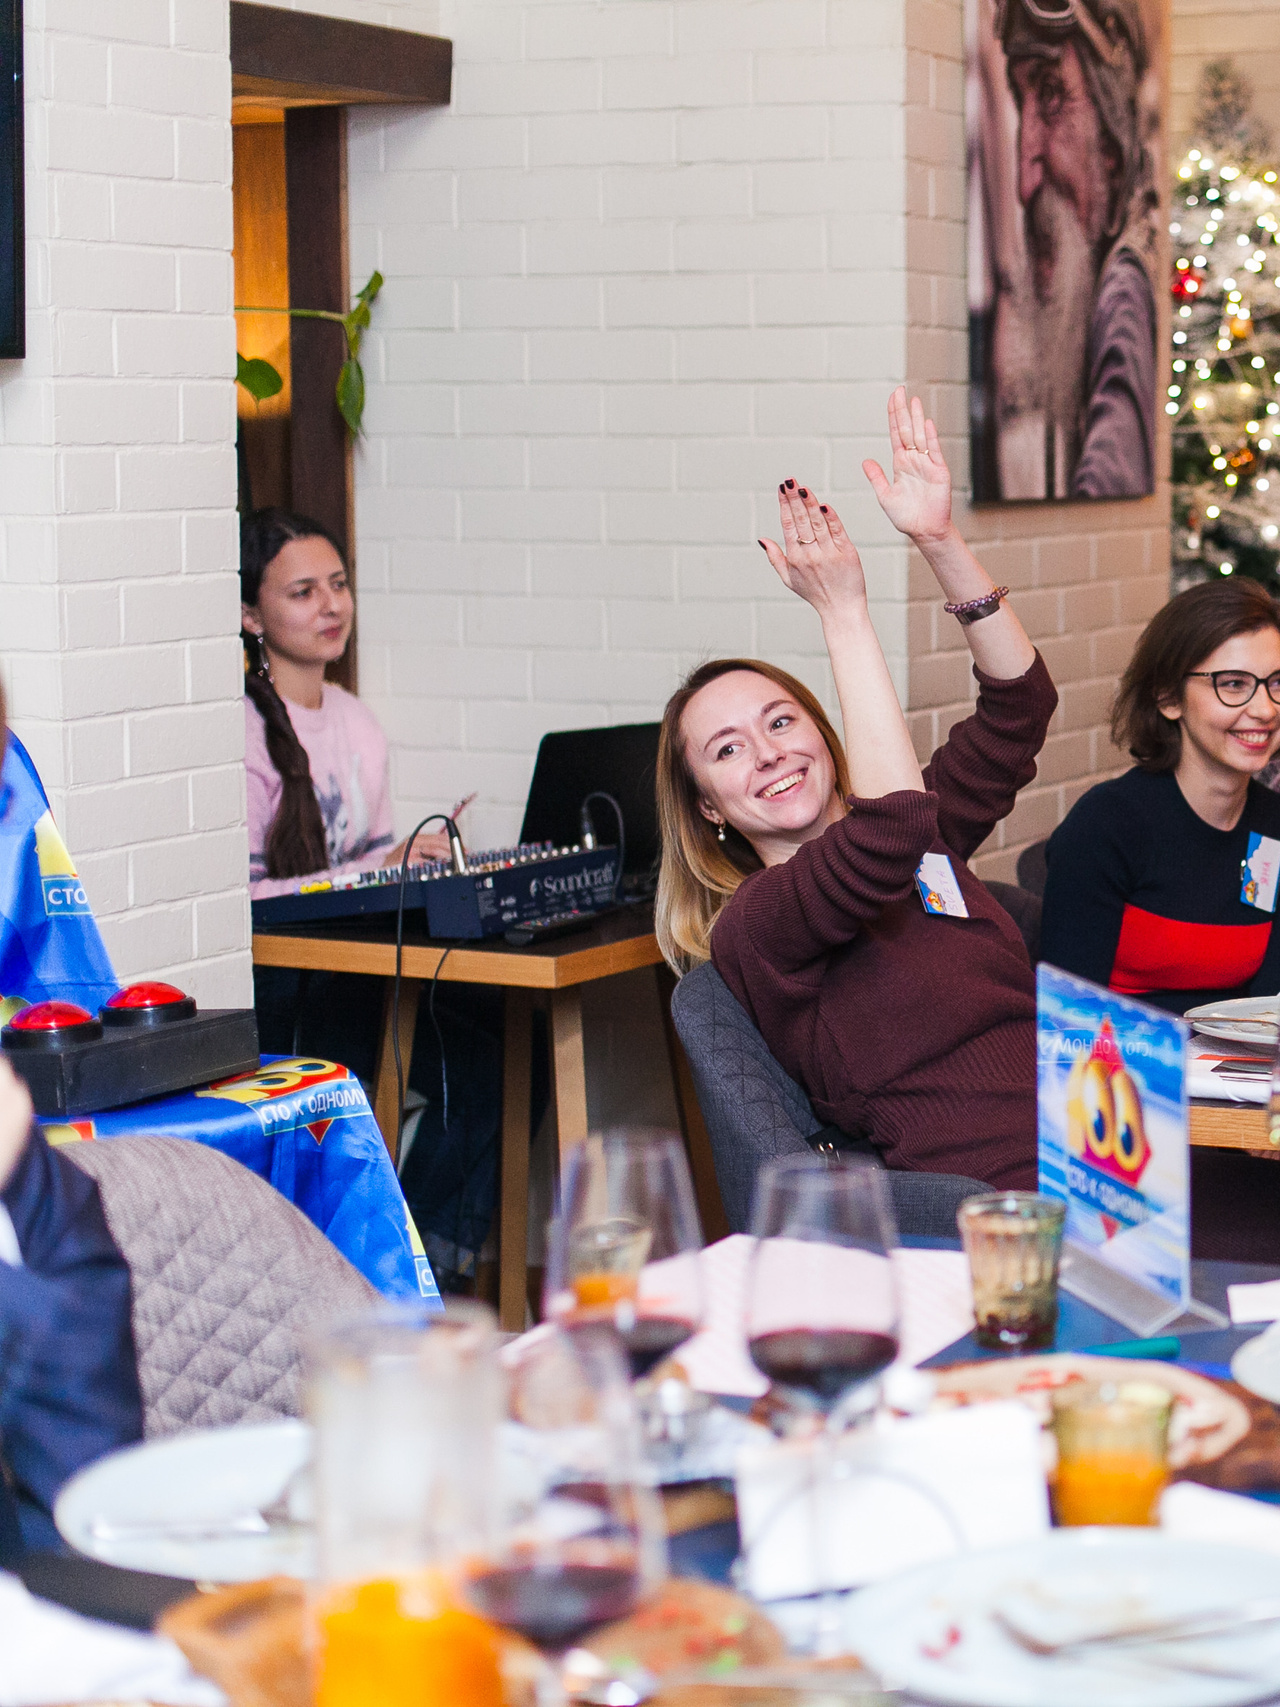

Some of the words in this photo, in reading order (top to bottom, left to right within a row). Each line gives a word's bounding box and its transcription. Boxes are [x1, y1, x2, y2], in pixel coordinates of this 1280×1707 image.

[48, 888, 88, 905] СТО
[260, 1104, 291, 1125] СТО
[295, 1100, 304, 1116] К
[308, 1088, 368, 1114] ОДНОМУ
